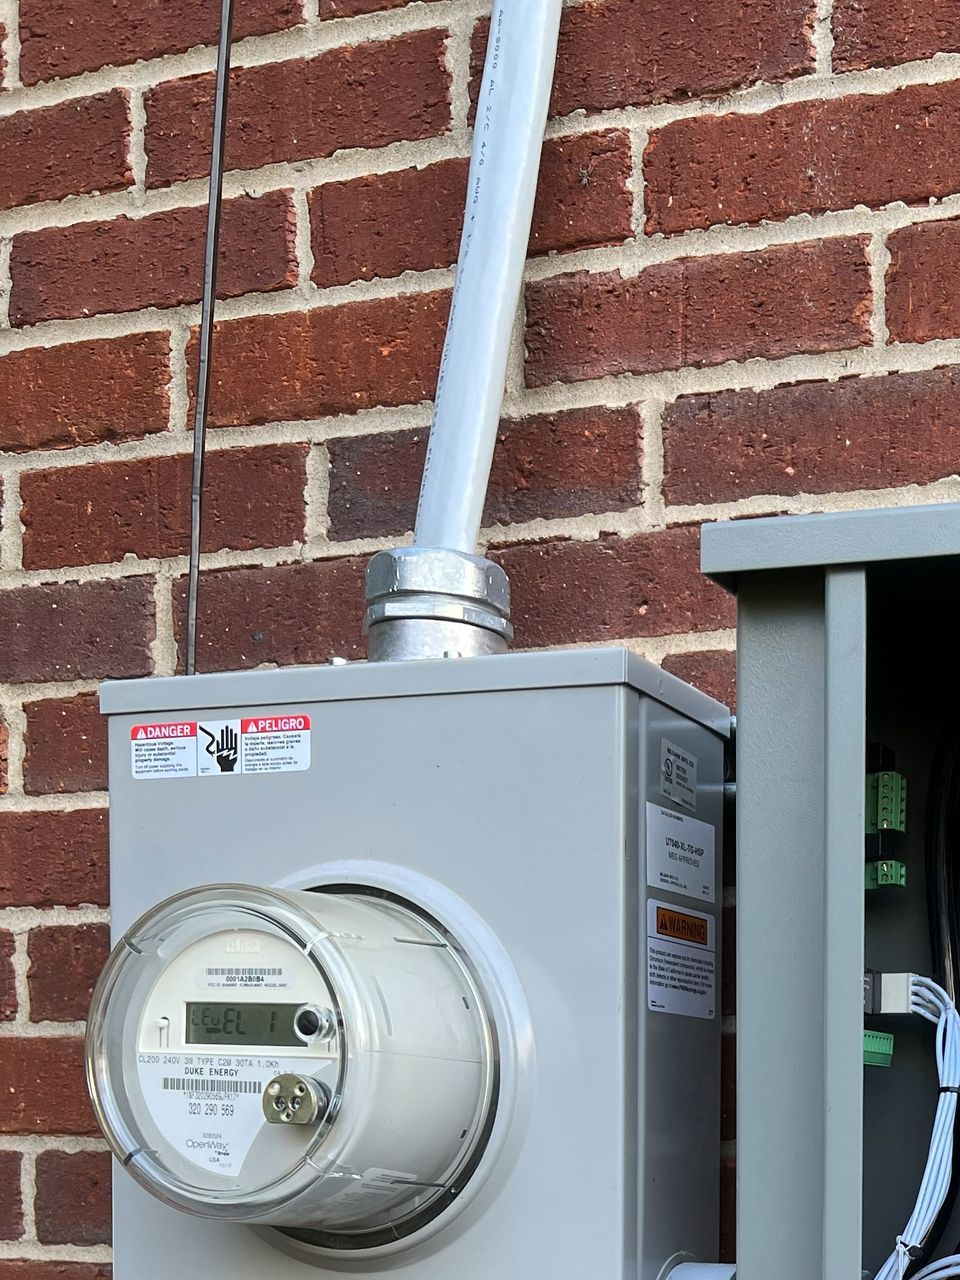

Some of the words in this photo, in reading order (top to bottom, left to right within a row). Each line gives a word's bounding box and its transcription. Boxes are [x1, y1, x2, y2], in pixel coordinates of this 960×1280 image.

[488, 80, 496, 96] AL
[258, 718, 304, 731] PELIGRO
[147, 725, 191, 738] DANGER
[669, 915, 705, 940] WARNING
[138, 1055, 159, 1064] CL200
[163, 1056, 180, 1064] 240V
[197, 1058, 214, 1066] TYPE
[235, 1059, 253, 1067] 30TA
[184, 1067, 204, 1075] DUKE
[209, 1067, 240, 1076] ENERGY
[188, 1102, 201, 1114] 320
[205, 1103, 218, 1116] 290
[221, 1104, 234, 1116] 569
